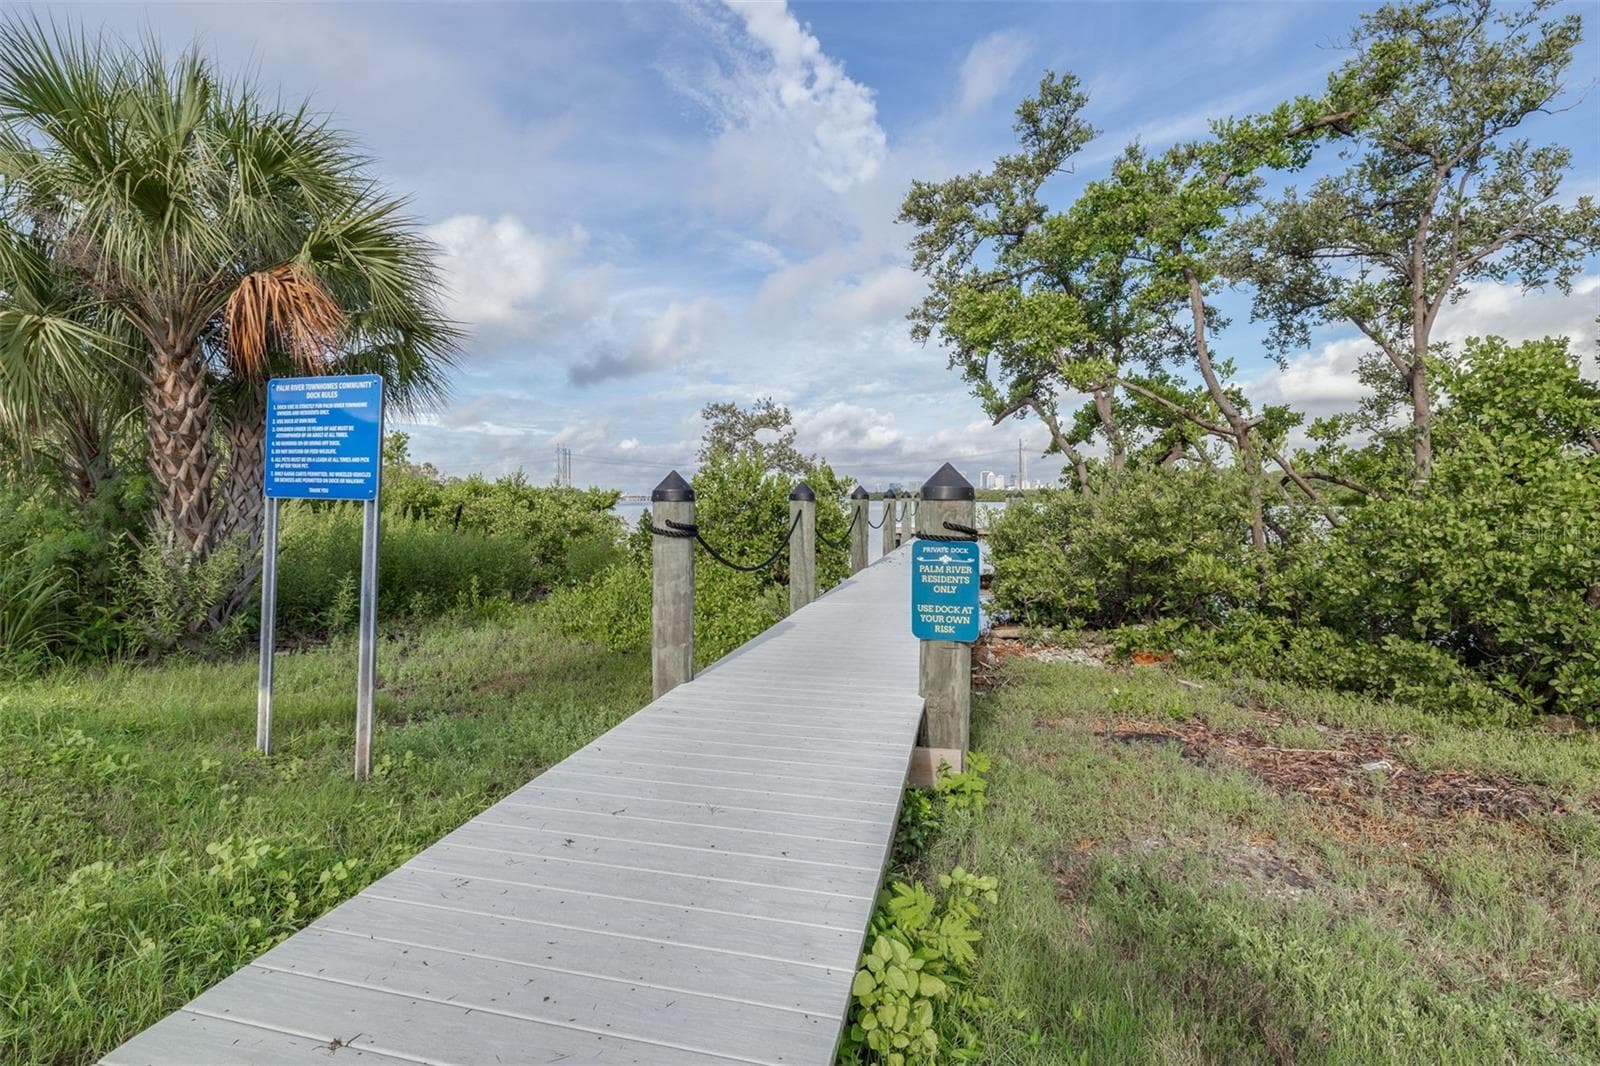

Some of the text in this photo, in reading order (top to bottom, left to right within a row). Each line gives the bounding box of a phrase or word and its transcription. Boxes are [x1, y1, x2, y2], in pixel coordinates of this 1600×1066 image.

[306, 382, 338, 390] TOWNHOMES
[922, 576, 970, 584] RESIDENTS
[935, 605, 960, 614] DOCK
[946, 616, 970, 624] OWN
